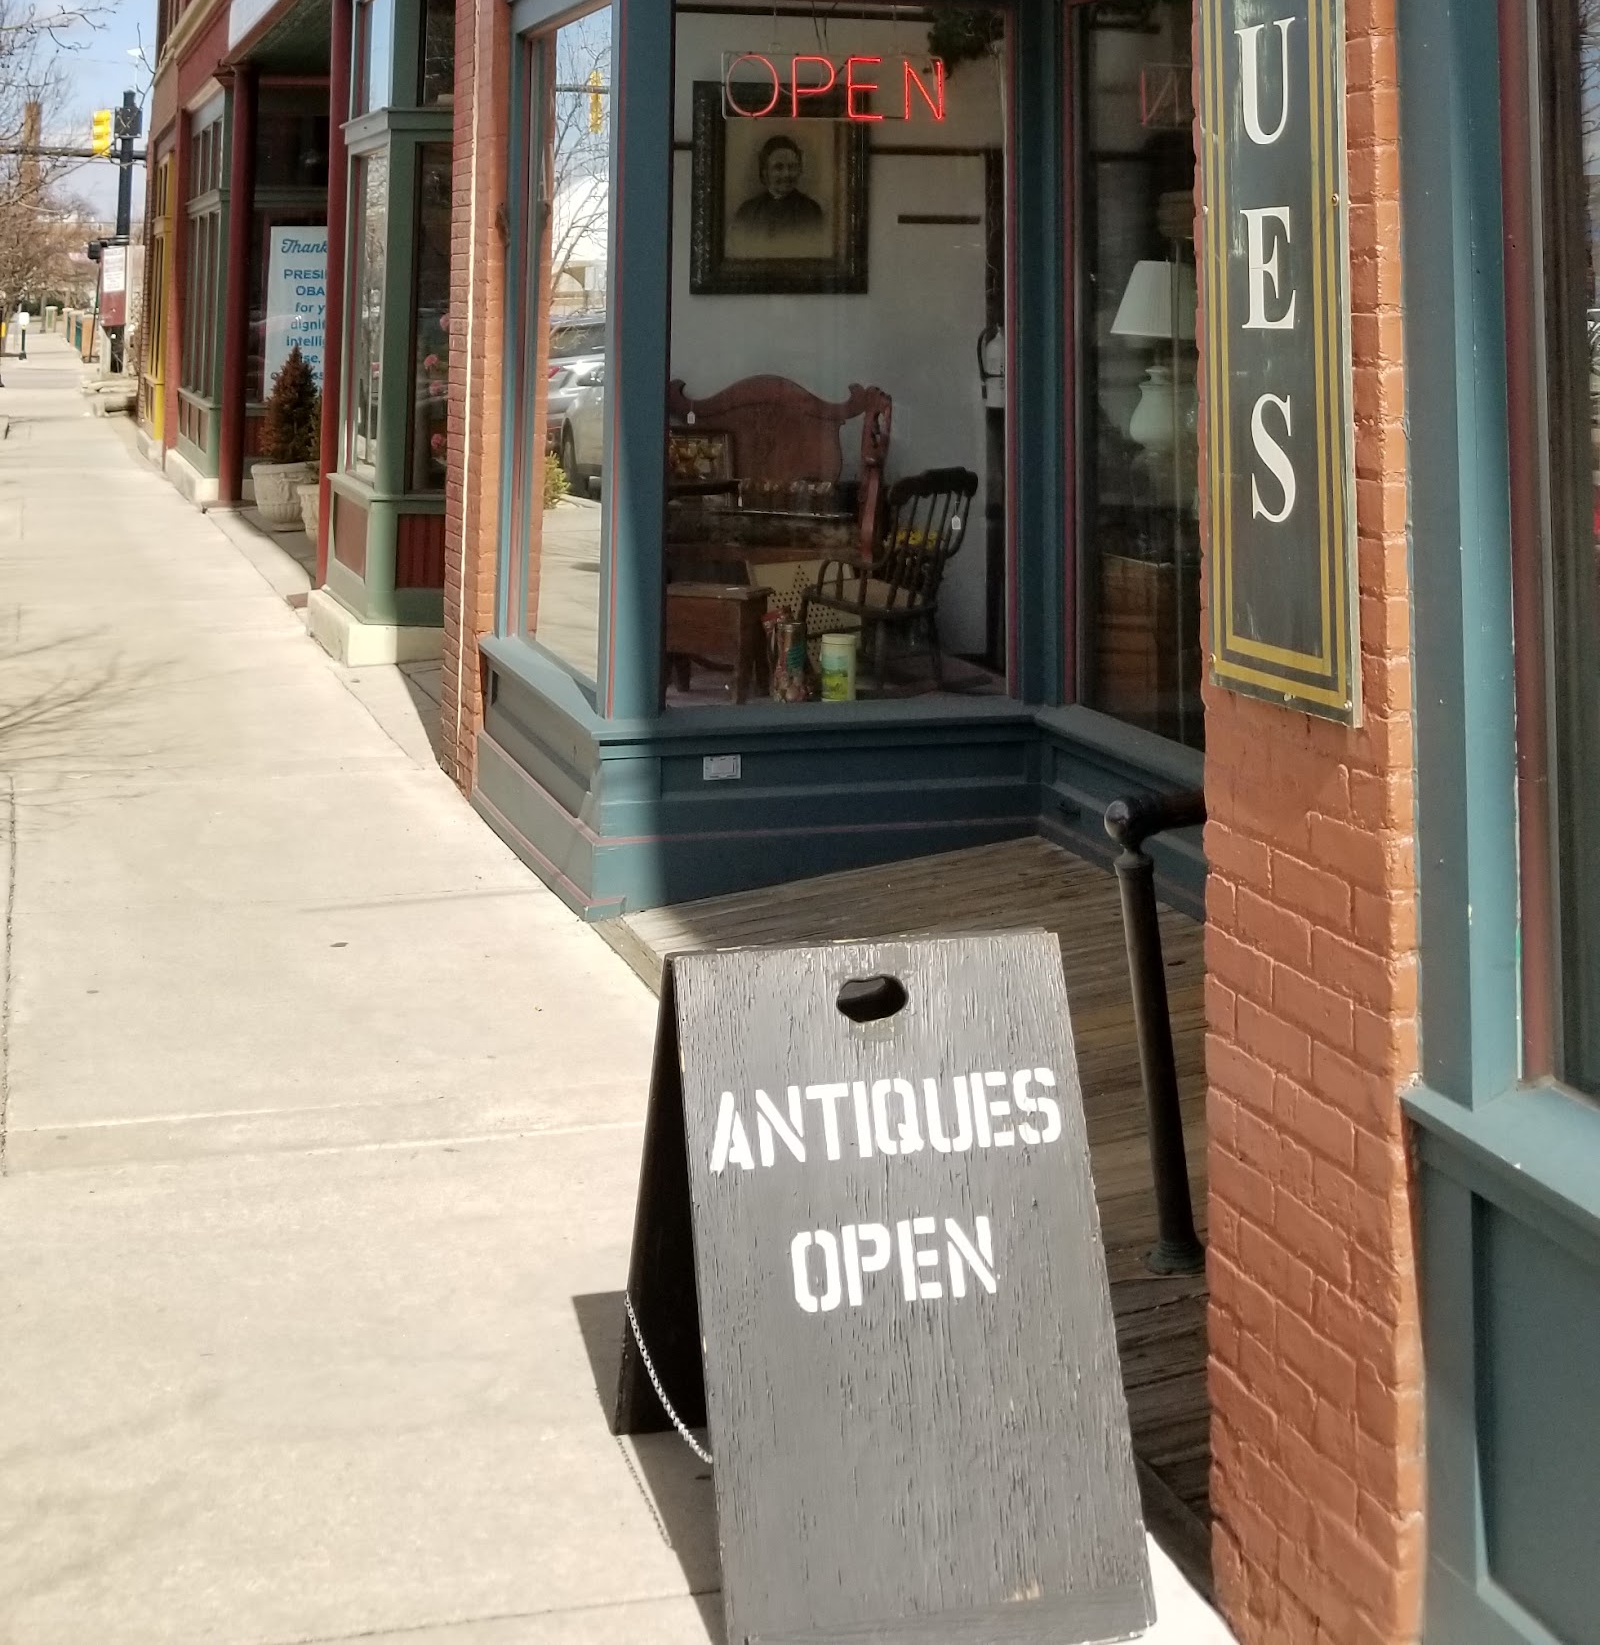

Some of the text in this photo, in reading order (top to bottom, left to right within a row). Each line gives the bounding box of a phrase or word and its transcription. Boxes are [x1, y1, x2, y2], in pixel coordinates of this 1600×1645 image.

[726, 54, 944, 120] OPEN
[281, 238, 327, 254] Thank
[283, 268, 327, 280] PRESI
[295, 302, 314, 313] for
[286, 335, 325, 347] intelli
[709, 1067, 1062, 1176] ANTIQUES
[791, 1216, 997, 1313] OPEN
